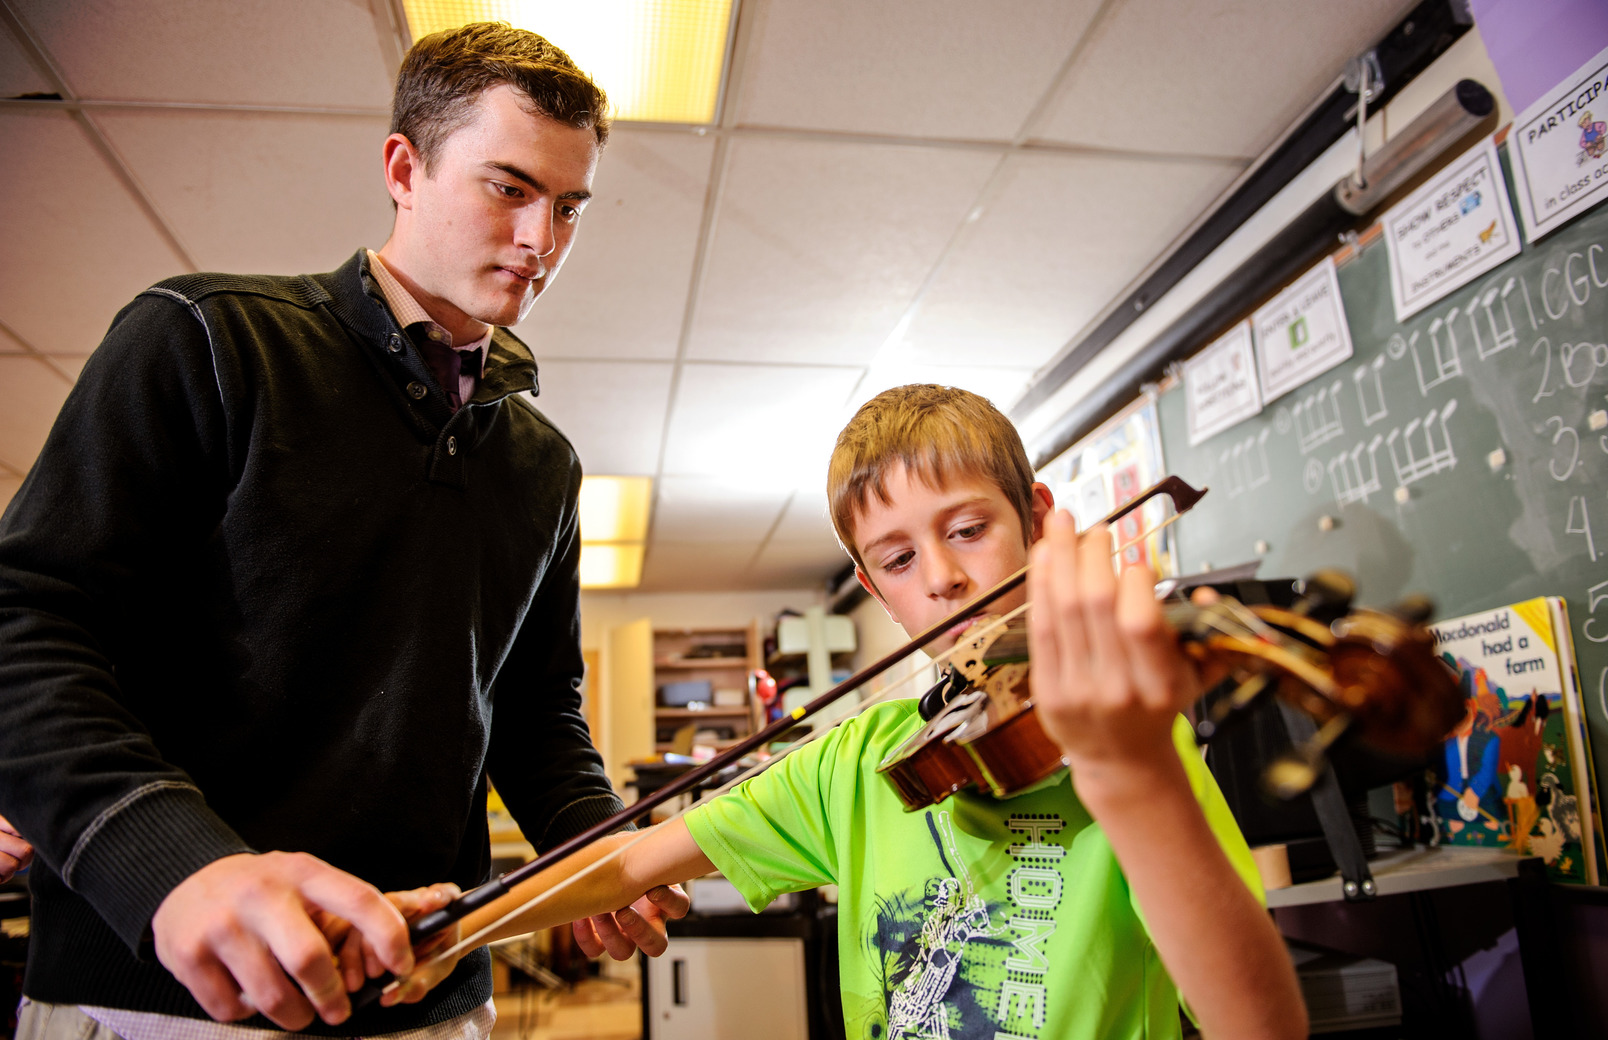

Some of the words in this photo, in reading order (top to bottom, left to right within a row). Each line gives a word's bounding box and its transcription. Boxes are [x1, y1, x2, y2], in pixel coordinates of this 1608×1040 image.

[1397, 206, 1432, 242] SHOW
[1435, 165, 1488, 211] RESPECT
[1544, 196, 1558, 210] in
[1559, 173, 1591, 202] class
[1411, 245, 1481, 293] INSTRUMENTS
[1482, 635, 1513, 657] had
[1518, 637, 1529, 649] a
[1505, 657, 1546, 676] farm
